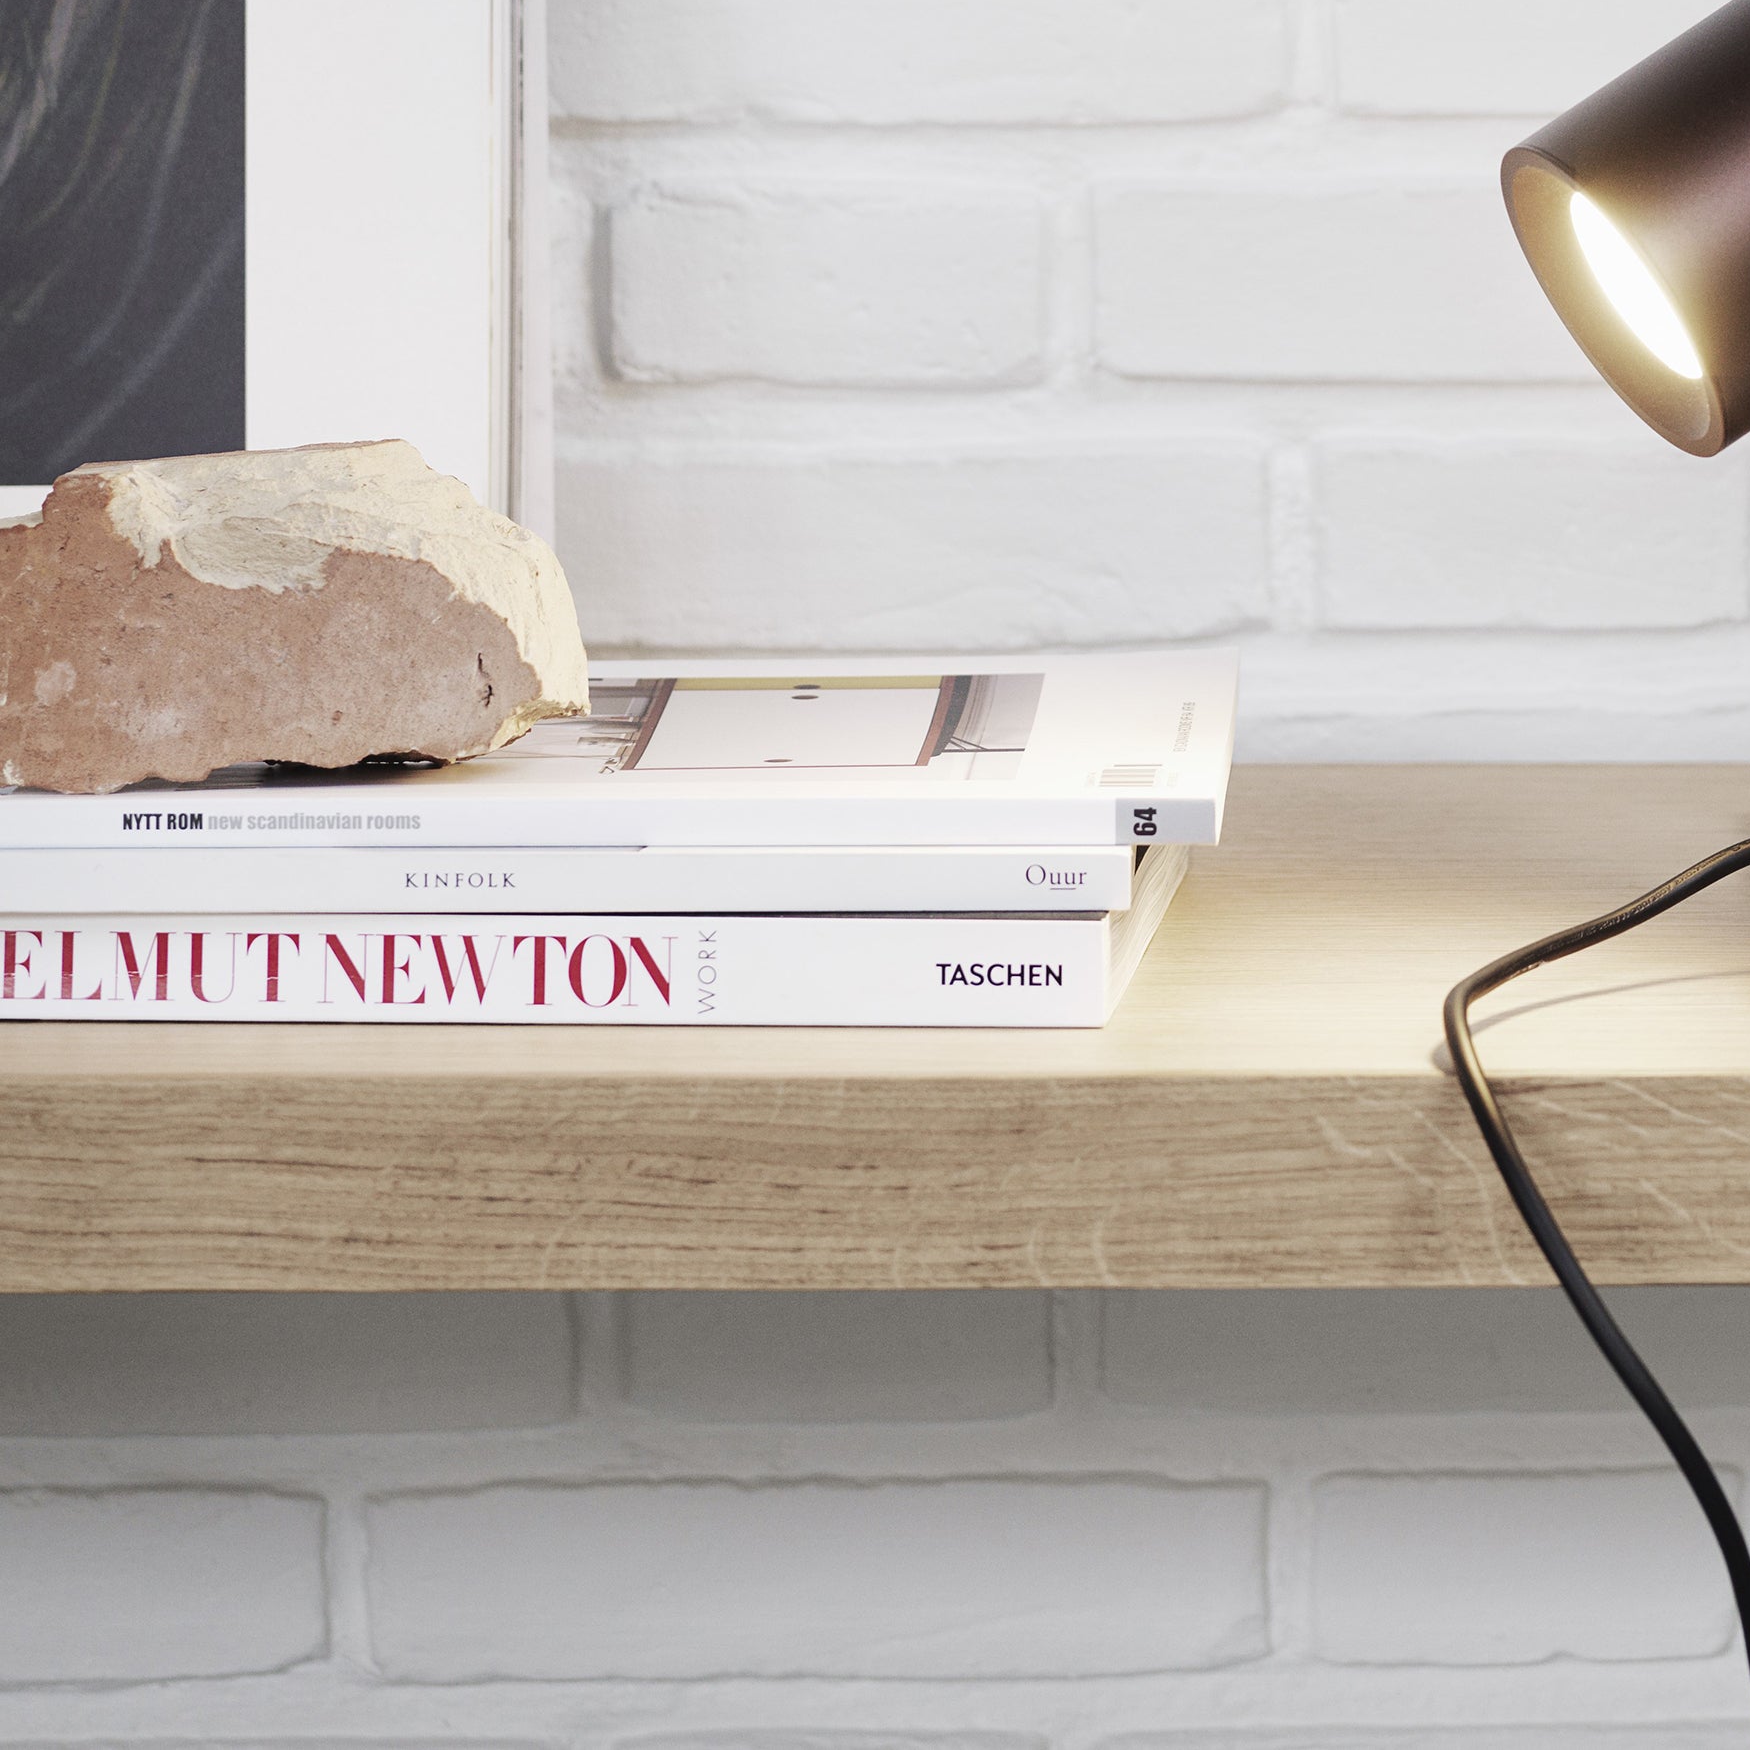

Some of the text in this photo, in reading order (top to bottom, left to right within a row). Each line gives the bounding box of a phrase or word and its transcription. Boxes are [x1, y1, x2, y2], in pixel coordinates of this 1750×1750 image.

[122, 812, 422, 831] NYTT ROM new scandinavian rooms
[1132, 806, 1158, 837] 64
[404, 872, 517, 889] KINFOLK
[1025, 864, 1088, 890] Ouur
[317, 933, 679, 1008] NEWTON
[697, 930, 718, 1015] WORK
[935, 963, 1063, 987] TASCHEN
